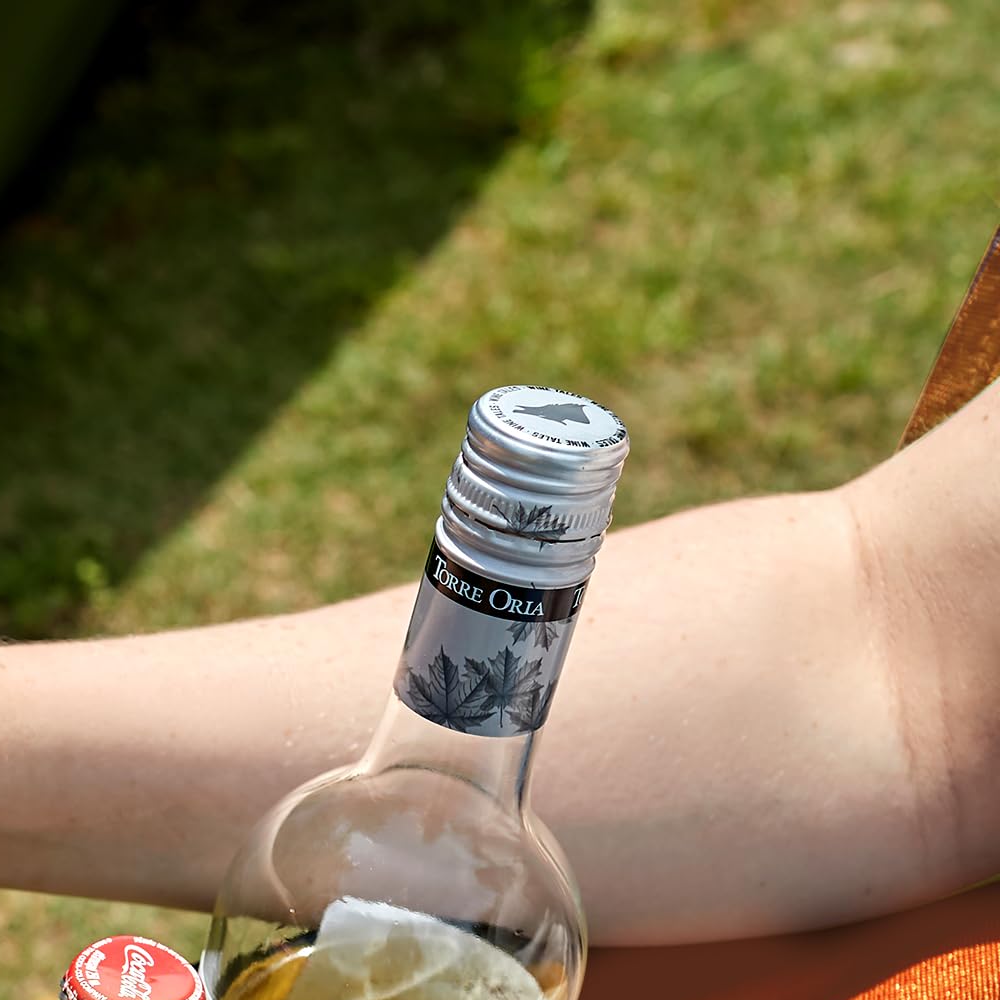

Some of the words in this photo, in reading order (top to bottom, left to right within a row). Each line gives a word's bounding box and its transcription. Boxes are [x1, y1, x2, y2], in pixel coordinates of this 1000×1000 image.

[532, 431, 563, 444] TALES
[565, 439, 591, 448] WINE
[433, 555, 484, 604] TORRE
[489, 588, 545, 617] ORIA
